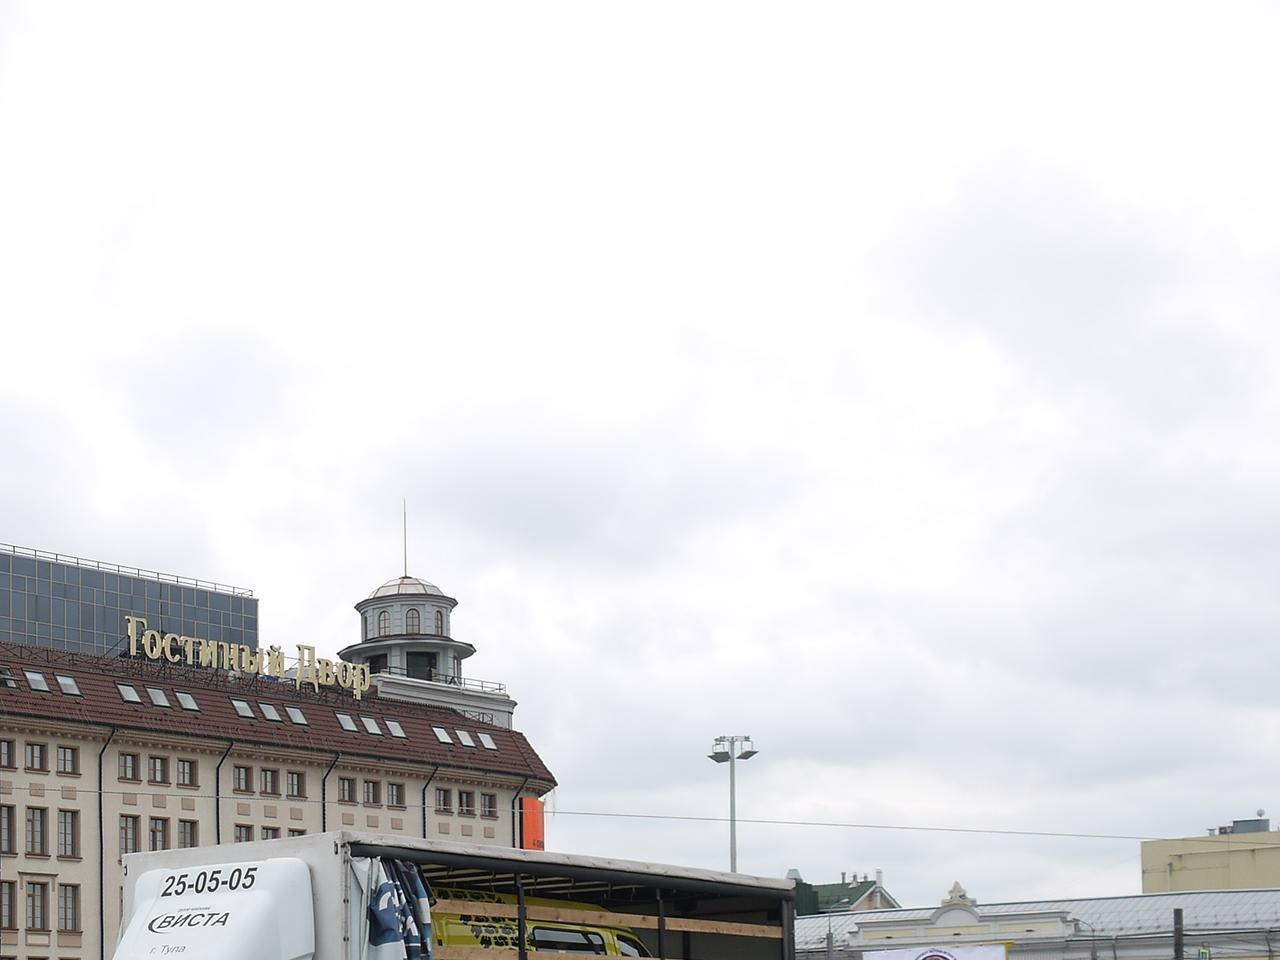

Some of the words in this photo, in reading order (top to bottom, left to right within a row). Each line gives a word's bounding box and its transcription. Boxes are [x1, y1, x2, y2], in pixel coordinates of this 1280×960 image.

[125, 616, 285, 678] Гостиный
[296, 644, 370, 700] Двор
[161, 867, 258, 897] 25-05-05
[156, 912, 230, 930] ВИСТА
